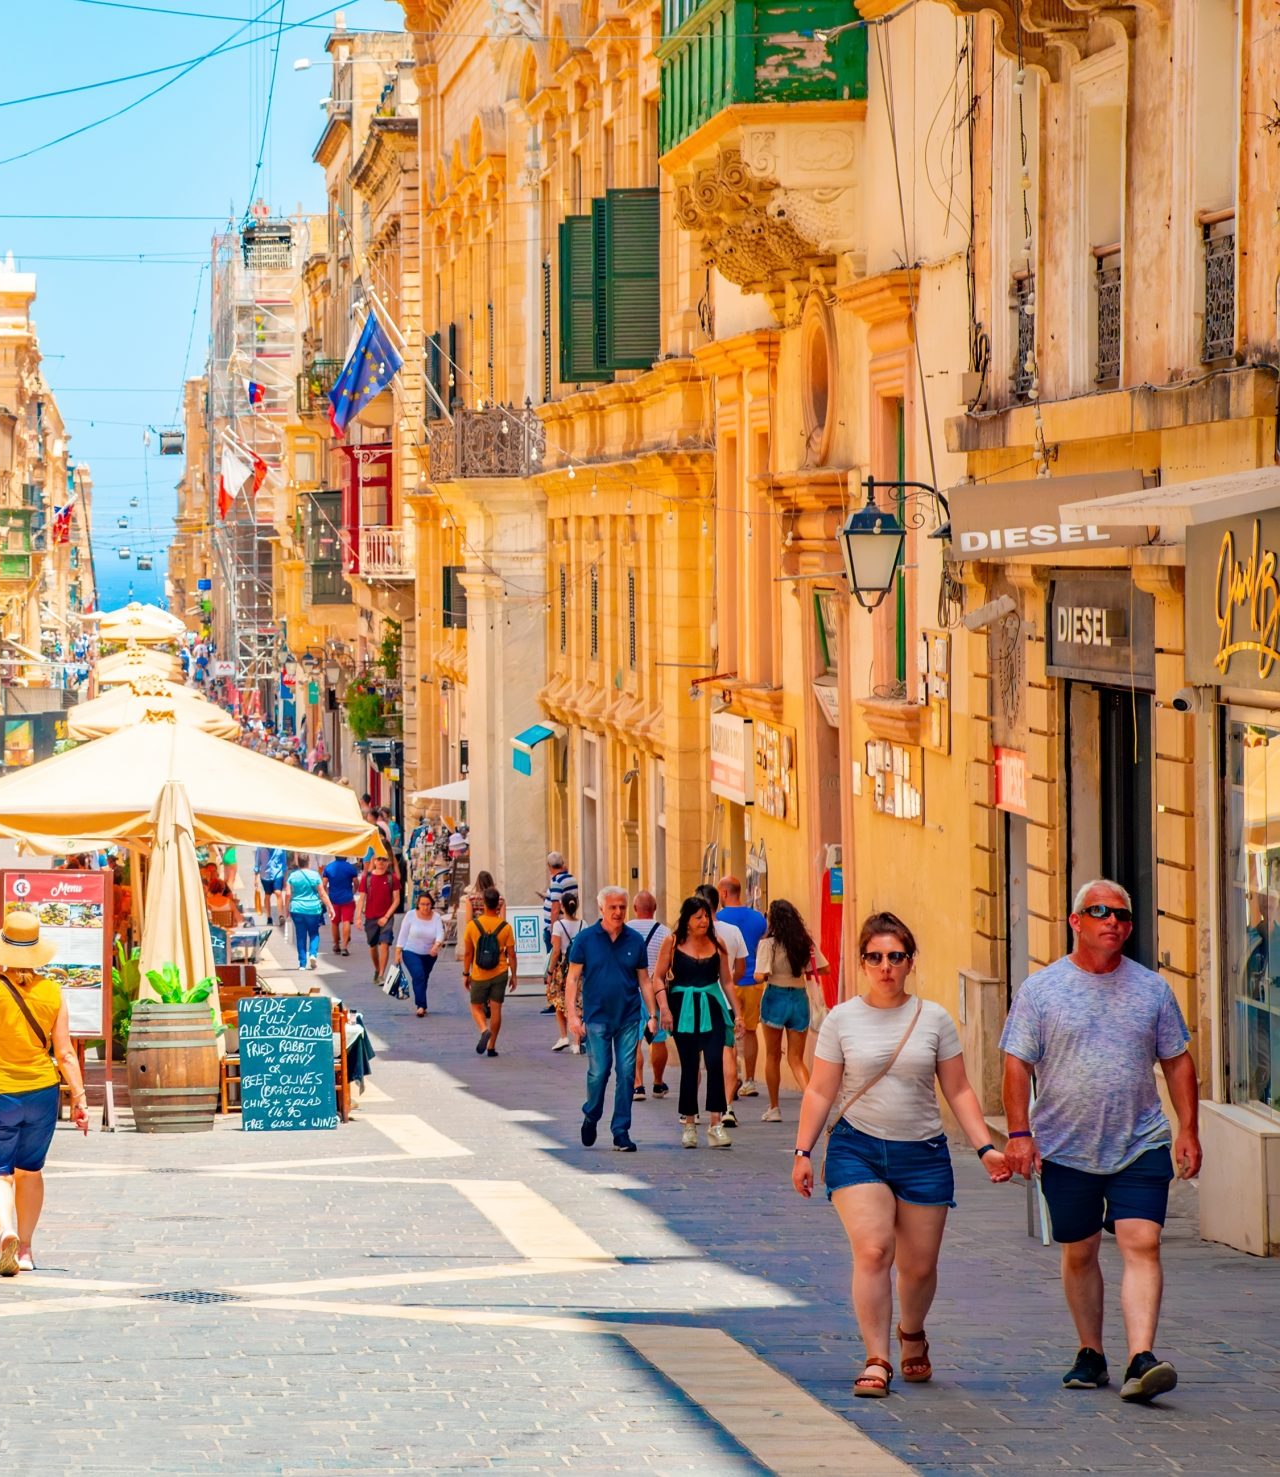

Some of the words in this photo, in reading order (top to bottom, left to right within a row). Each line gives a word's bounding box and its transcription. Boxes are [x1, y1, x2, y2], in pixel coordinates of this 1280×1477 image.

[960, 523, 1111, 552] DIESEL
[1057, 606, 1111, 647] DIESEL
[50, 882, 83, 897] Menu
[239, 998, 288, 1014] INSIDE
[298, 1000, 313, 1013] IS
[259, 1012, 297, 1026] FULLY
[246, 1040, 275, 1058] FRIED
[279, 1040, 318, 1054] RABBIT
[279, 1053, 316, 1066] GRAVY
[268, 1064, 281, 1074] OR
[242, 1073, 272, 1089] BEEF
[279, 1072, 324, 1085] OLIVES
[243, 1098, 271, 1109] CHIPS
[284, 1096, 322, 1107] SALAD
[244, 1118, 264, 1131] FREE
[311, 1116, 340, 1128] WINE
